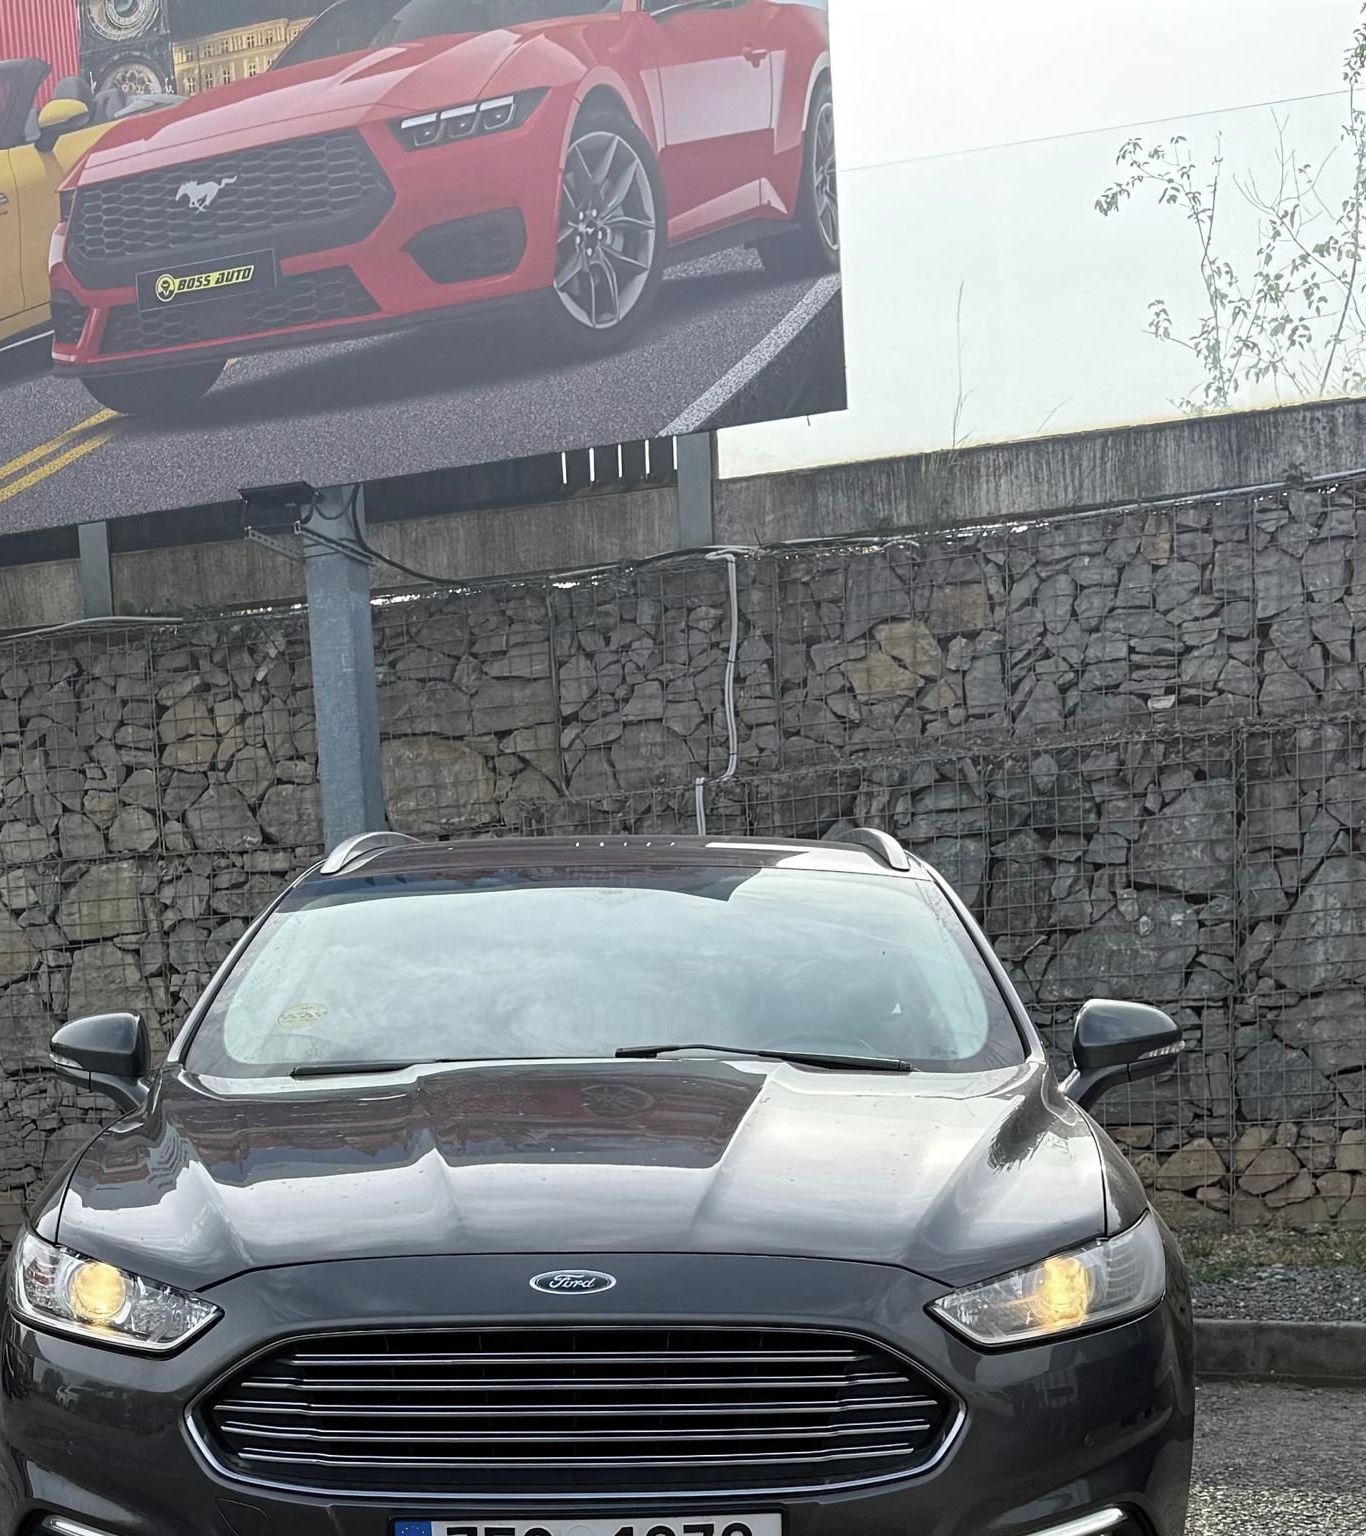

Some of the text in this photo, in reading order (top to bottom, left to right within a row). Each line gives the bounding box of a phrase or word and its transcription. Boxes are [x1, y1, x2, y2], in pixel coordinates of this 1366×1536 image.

[177, 267, 253, 291] BOSS AUTO
[548, 1274, 596, 1289] Ford
